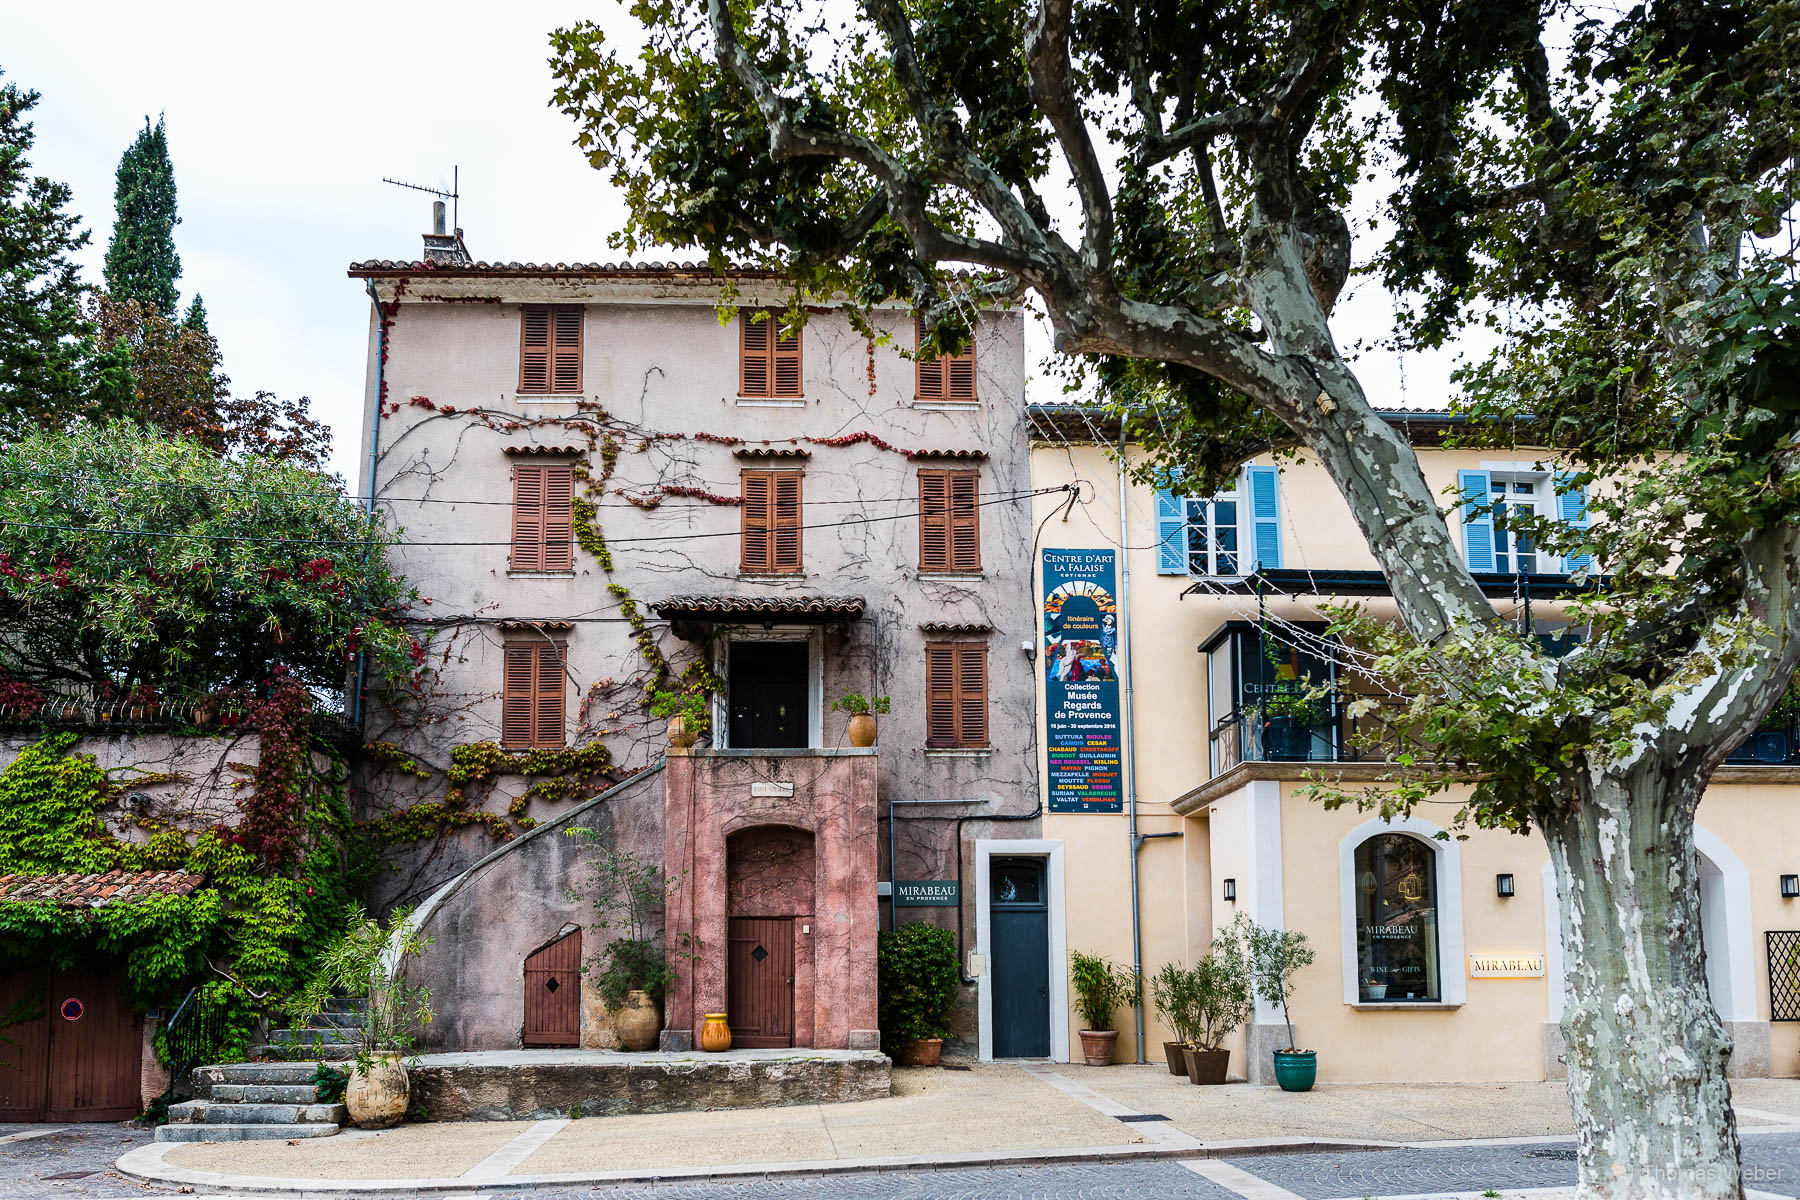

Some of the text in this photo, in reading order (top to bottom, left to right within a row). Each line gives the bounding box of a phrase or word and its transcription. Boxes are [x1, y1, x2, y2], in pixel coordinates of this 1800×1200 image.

[1044, 554, 1114, 563] CENTRE D'ART
[1068, 564, 1104, 572] FALAISE
[1064, 701, 1102, 710] Regards
[899, 886, 956, 896] MIRABEAU
[1366, 925, 1418, 934] MIRABEAU
[1475, 960, 1541, 971] MIRABEAU
